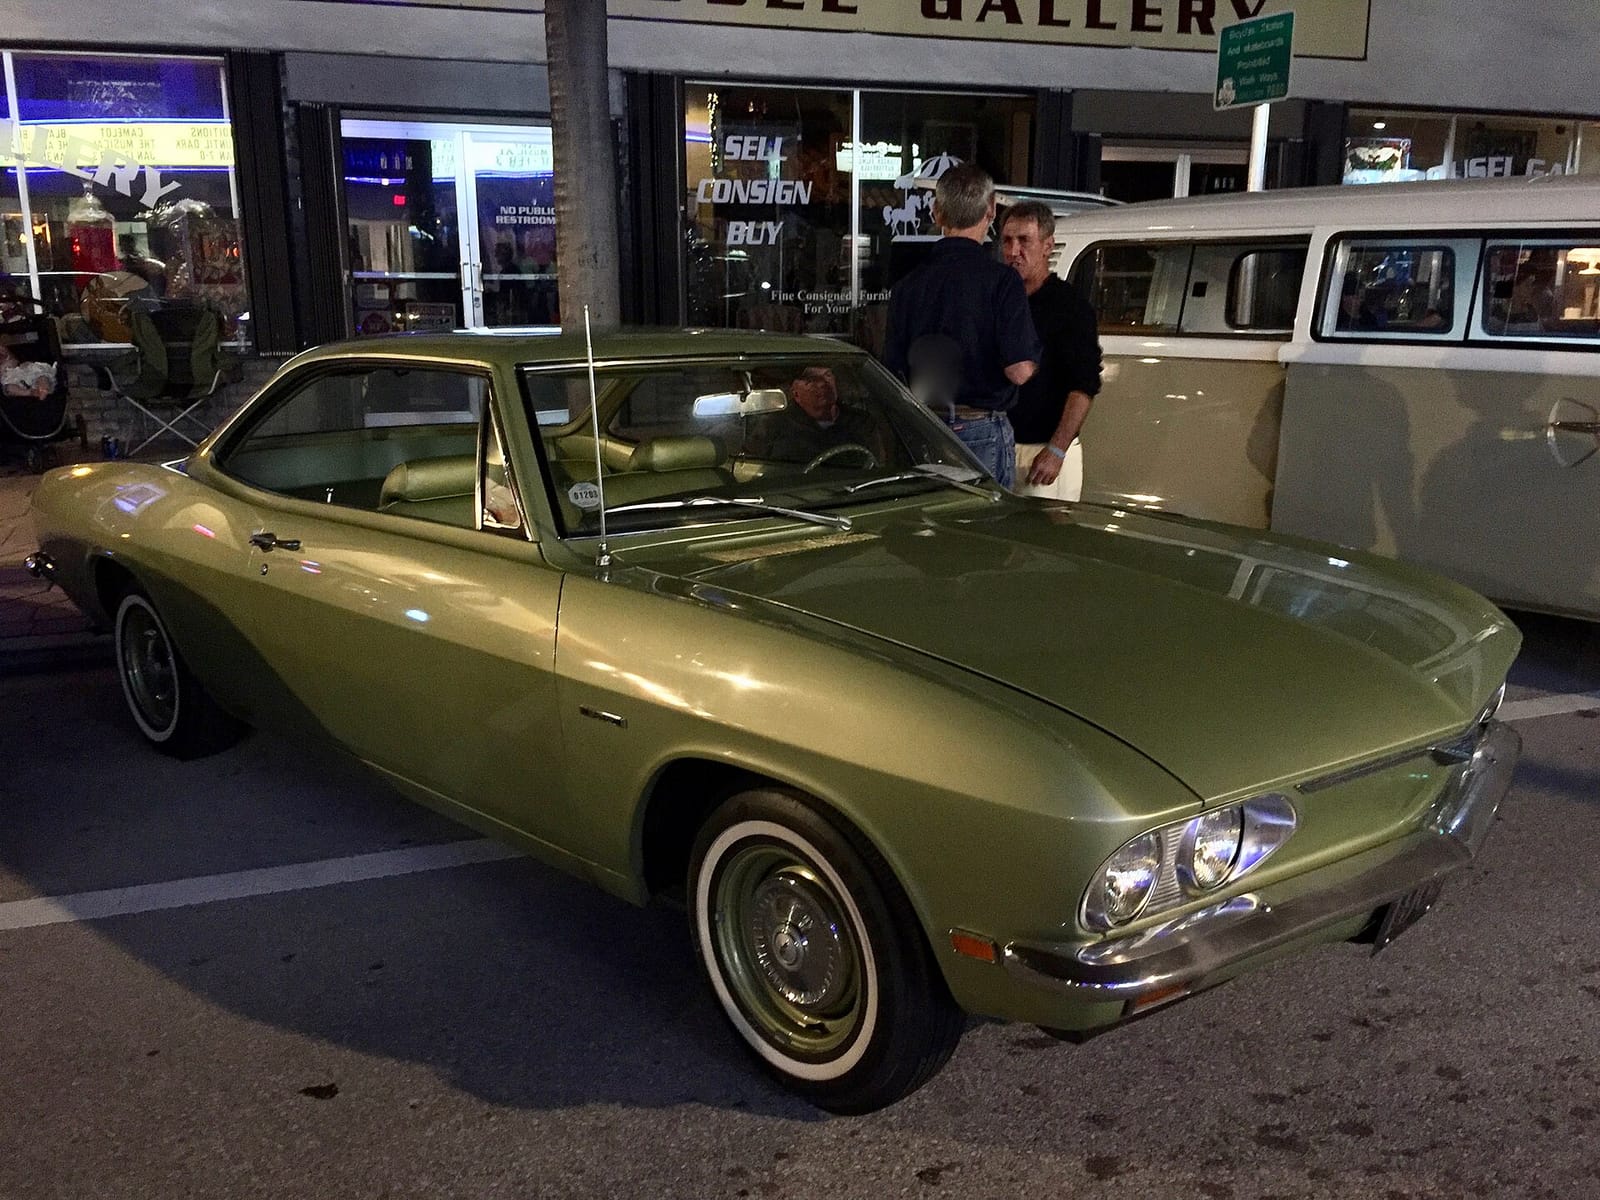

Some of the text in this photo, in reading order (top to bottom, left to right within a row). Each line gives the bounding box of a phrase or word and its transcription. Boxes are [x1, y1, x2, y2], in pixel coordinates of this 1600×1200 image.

[724, 135, 787, 161] SELL
[697, 179, 813, 205] CONSIGN
[500, 206, 517, 215] NO
[495, 215, 556, 225] RESTROOM
[727, 221, 784, 245] BUY
[771, 290, 794, 301] Fine
[797, 290, 852, 303] Consigned
[804, 302, 823, 314] For
[826, 302, 851, 314] Your
